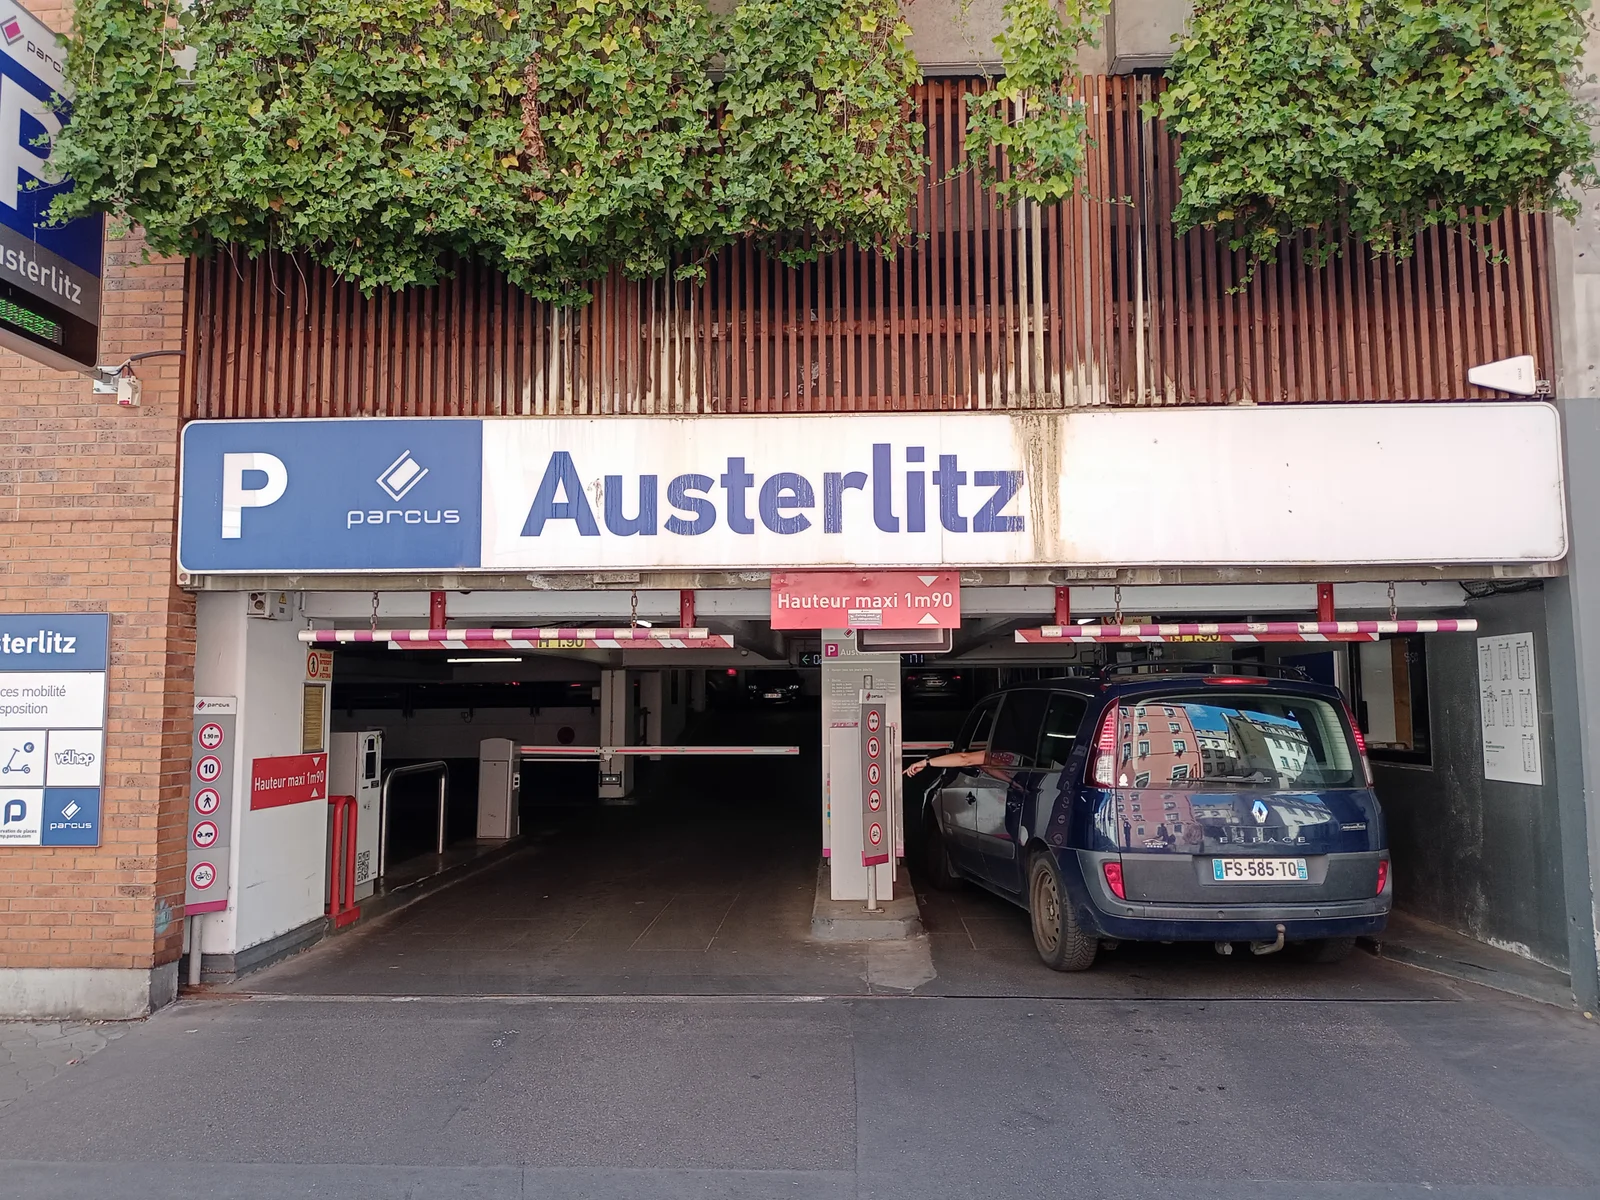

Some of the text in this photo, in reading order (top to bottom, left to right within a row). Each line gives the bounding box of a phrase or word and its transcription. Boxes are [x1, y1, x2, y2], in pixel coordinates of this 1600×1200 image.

[27, 40, 78, 85] parc
[222, 452, 288, 539] P
[519, 443, 1025, 537] Austerlitz
[347, 509, 460, 529] parcus
[777, 592, 953, 609] Hauteur maxi 1m90
[0, 630, 77, 653] terlitz
[827, 645, 836, 656] P
[22, 685, 66, 697] mobilité
[203, 763, 215, 774] 10
[254, 770, 325, 792] Hauteur maxi 1m90
[50, 822, 92, 831] parcus
[1223, 861, 1298, 877] FS-585-TQ
